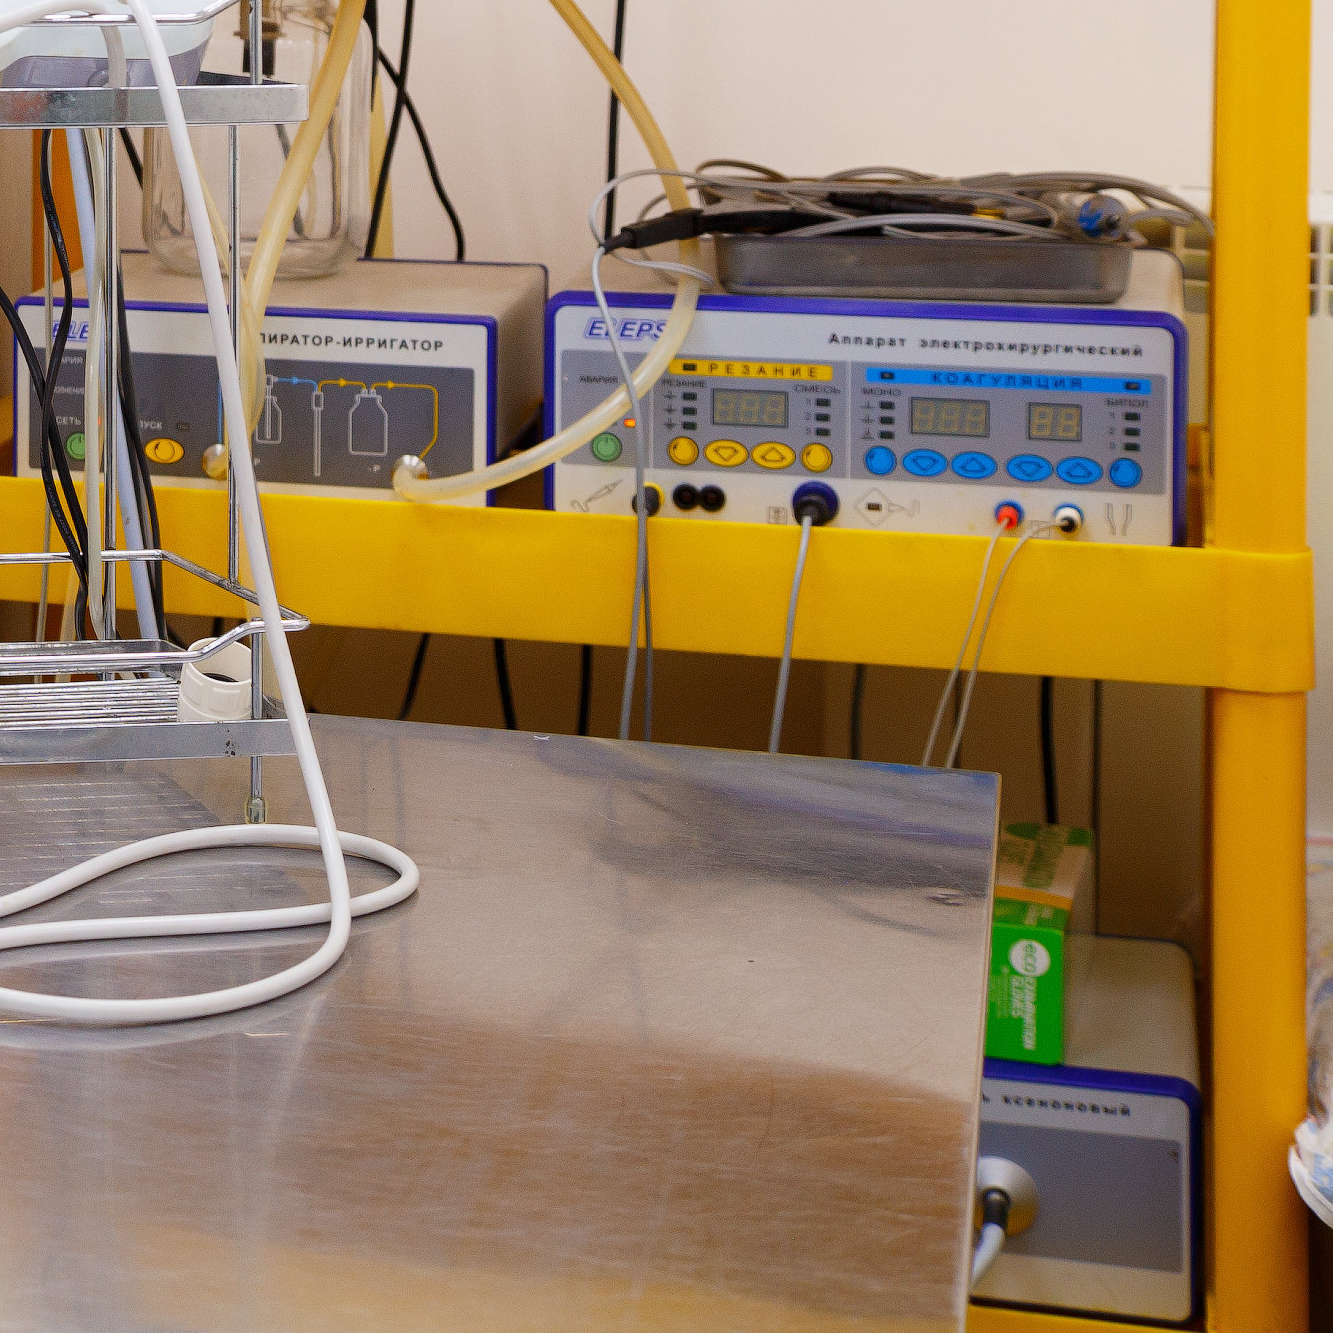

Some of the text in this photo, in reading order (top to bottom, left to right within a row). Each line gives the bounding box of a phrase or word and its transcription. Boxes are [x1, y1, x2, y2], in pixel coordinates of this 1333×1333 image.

[829, 333, 1144, 358] Аппарат электрохирургический
[708, 362, 818, 378] РЕЗАНИЕ
[933, 371, 1083, 389] КОАГУЛЯЦИЯ
[1001, 1093, 1131, 1117] ксеноновый
